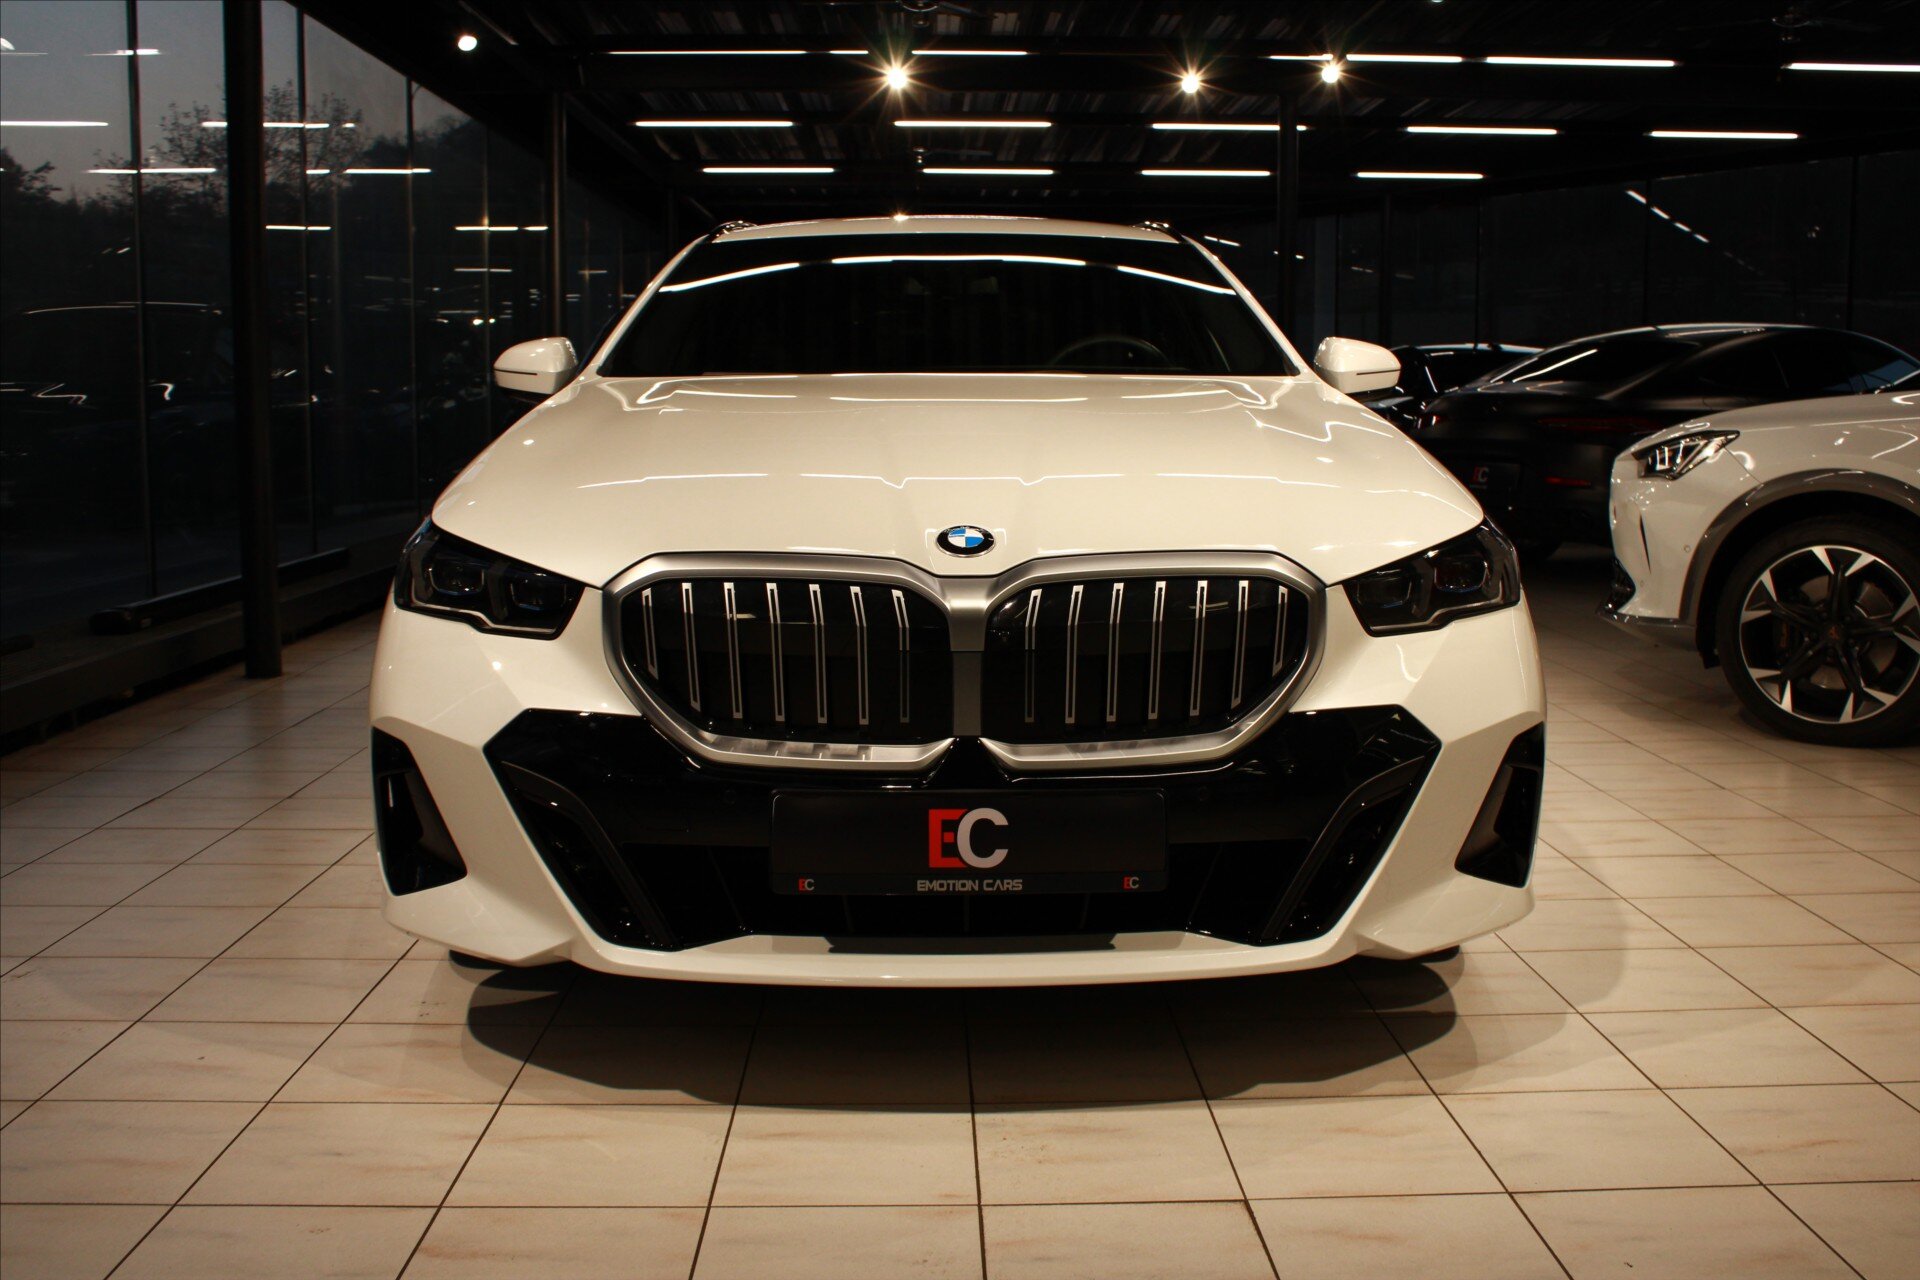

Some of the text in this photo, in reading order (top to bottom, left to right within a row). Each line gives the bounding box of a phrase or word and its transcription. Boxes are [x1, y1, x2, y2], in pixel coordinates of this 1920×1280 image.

[928, 807, 1009, 869] EC
[798, 878, 815, 892] EC
[916, 878, 1023, 892] EMOTION CARS
[1122, 876, 1140, 890] EC
